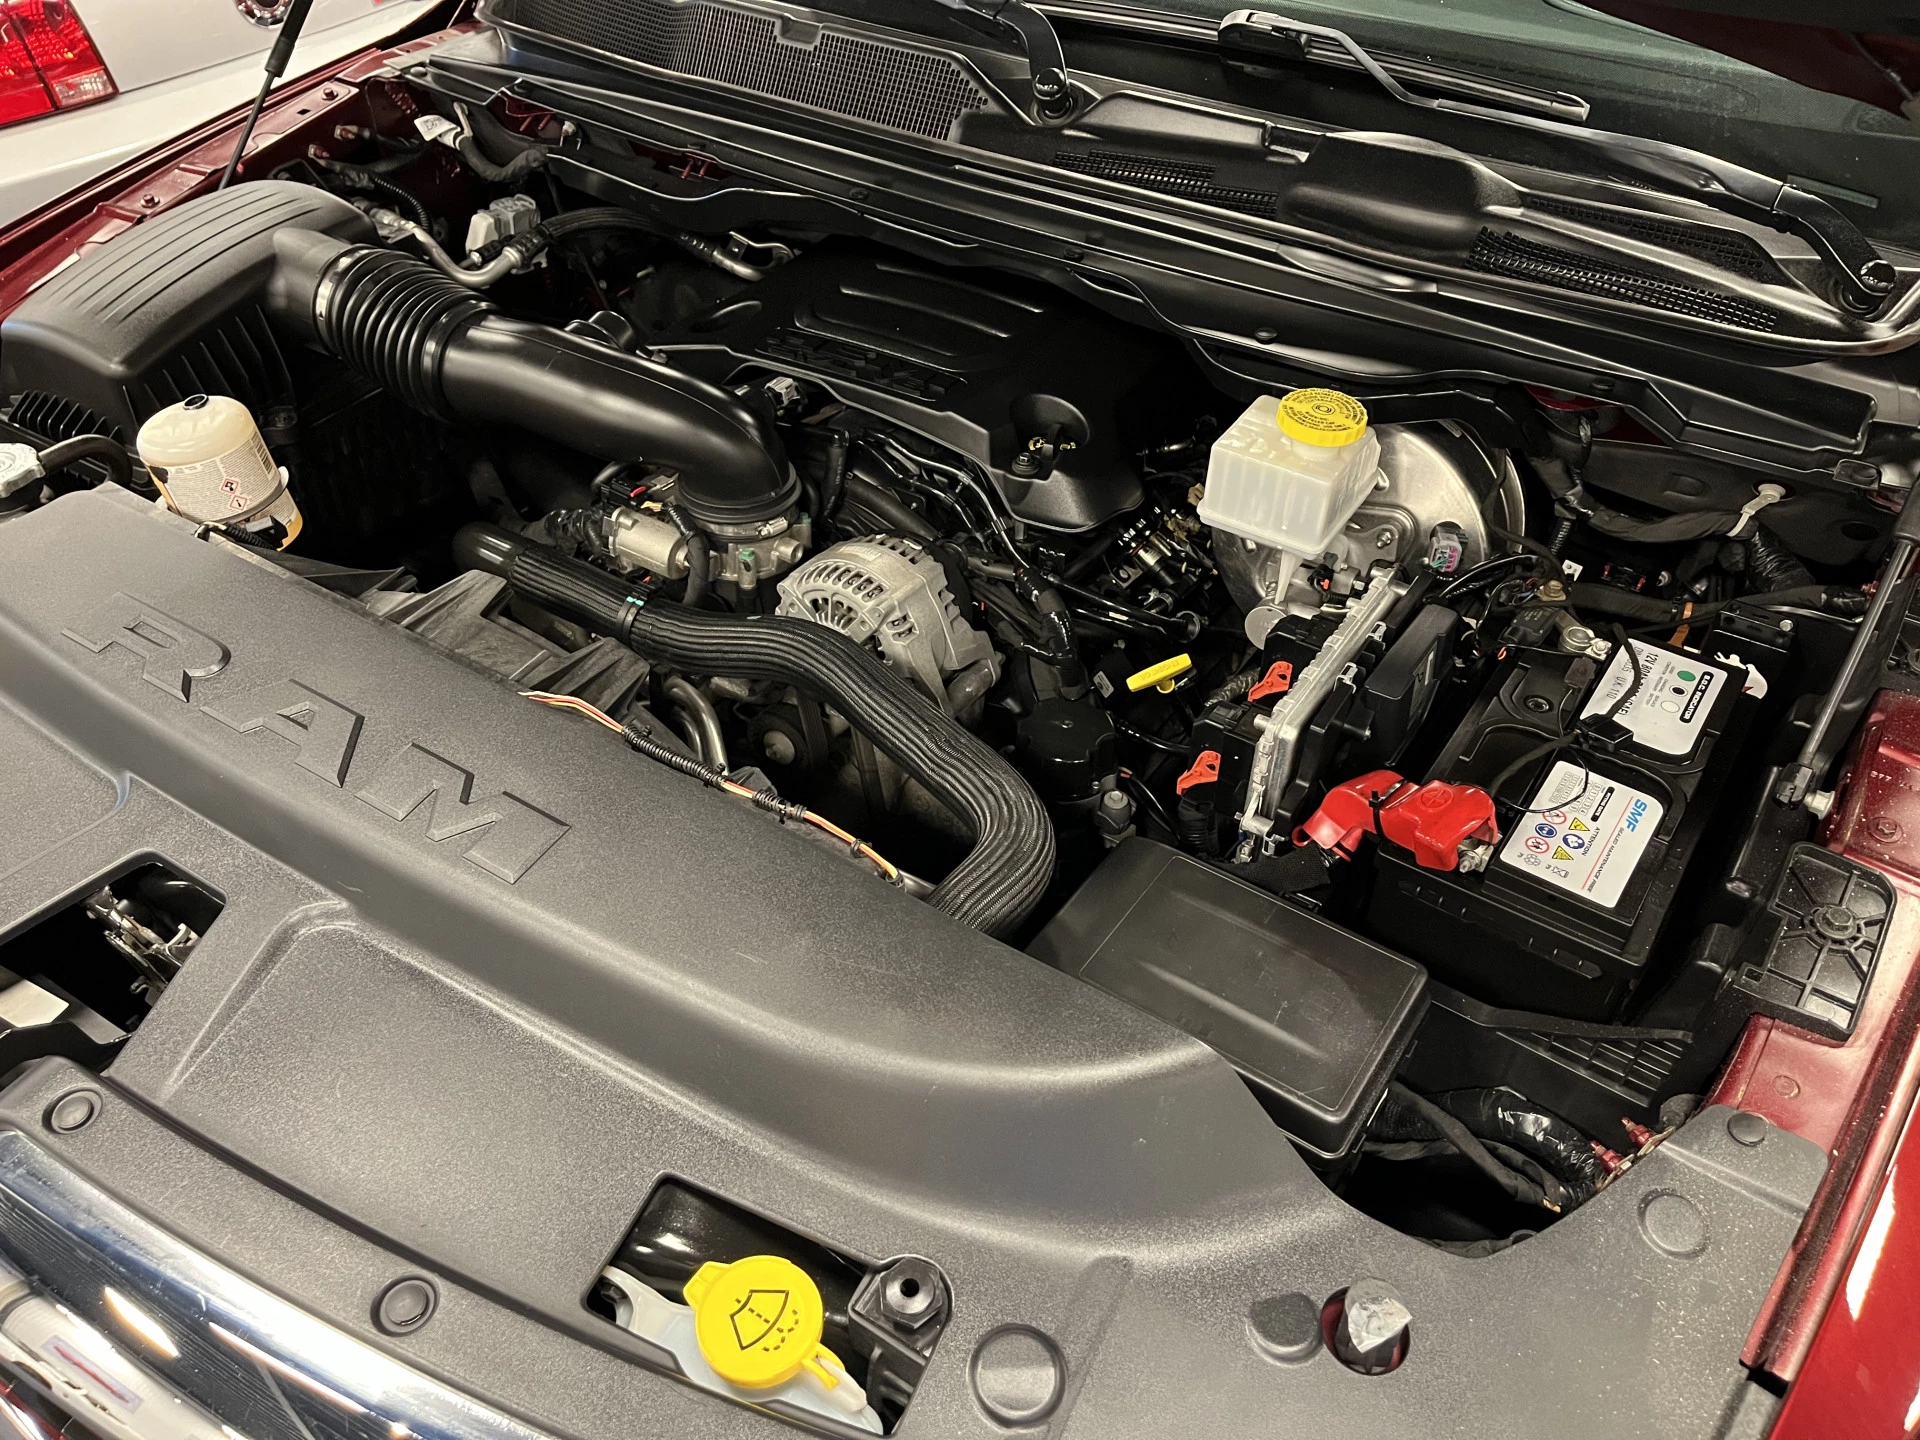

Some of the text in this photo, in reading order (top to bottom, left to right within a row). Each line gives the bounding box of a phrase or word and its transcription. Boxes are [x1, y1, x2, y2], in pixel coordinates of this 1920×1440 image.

[1644, 653, 1659, 665] 12V
[61, 591, 572, 885] RAM
[1625, 798, 1648, 832] SMF
[1581, 826, 1601, 856] ATTENTION
[1594, 844, 1615, 879] MAINTENANCE
